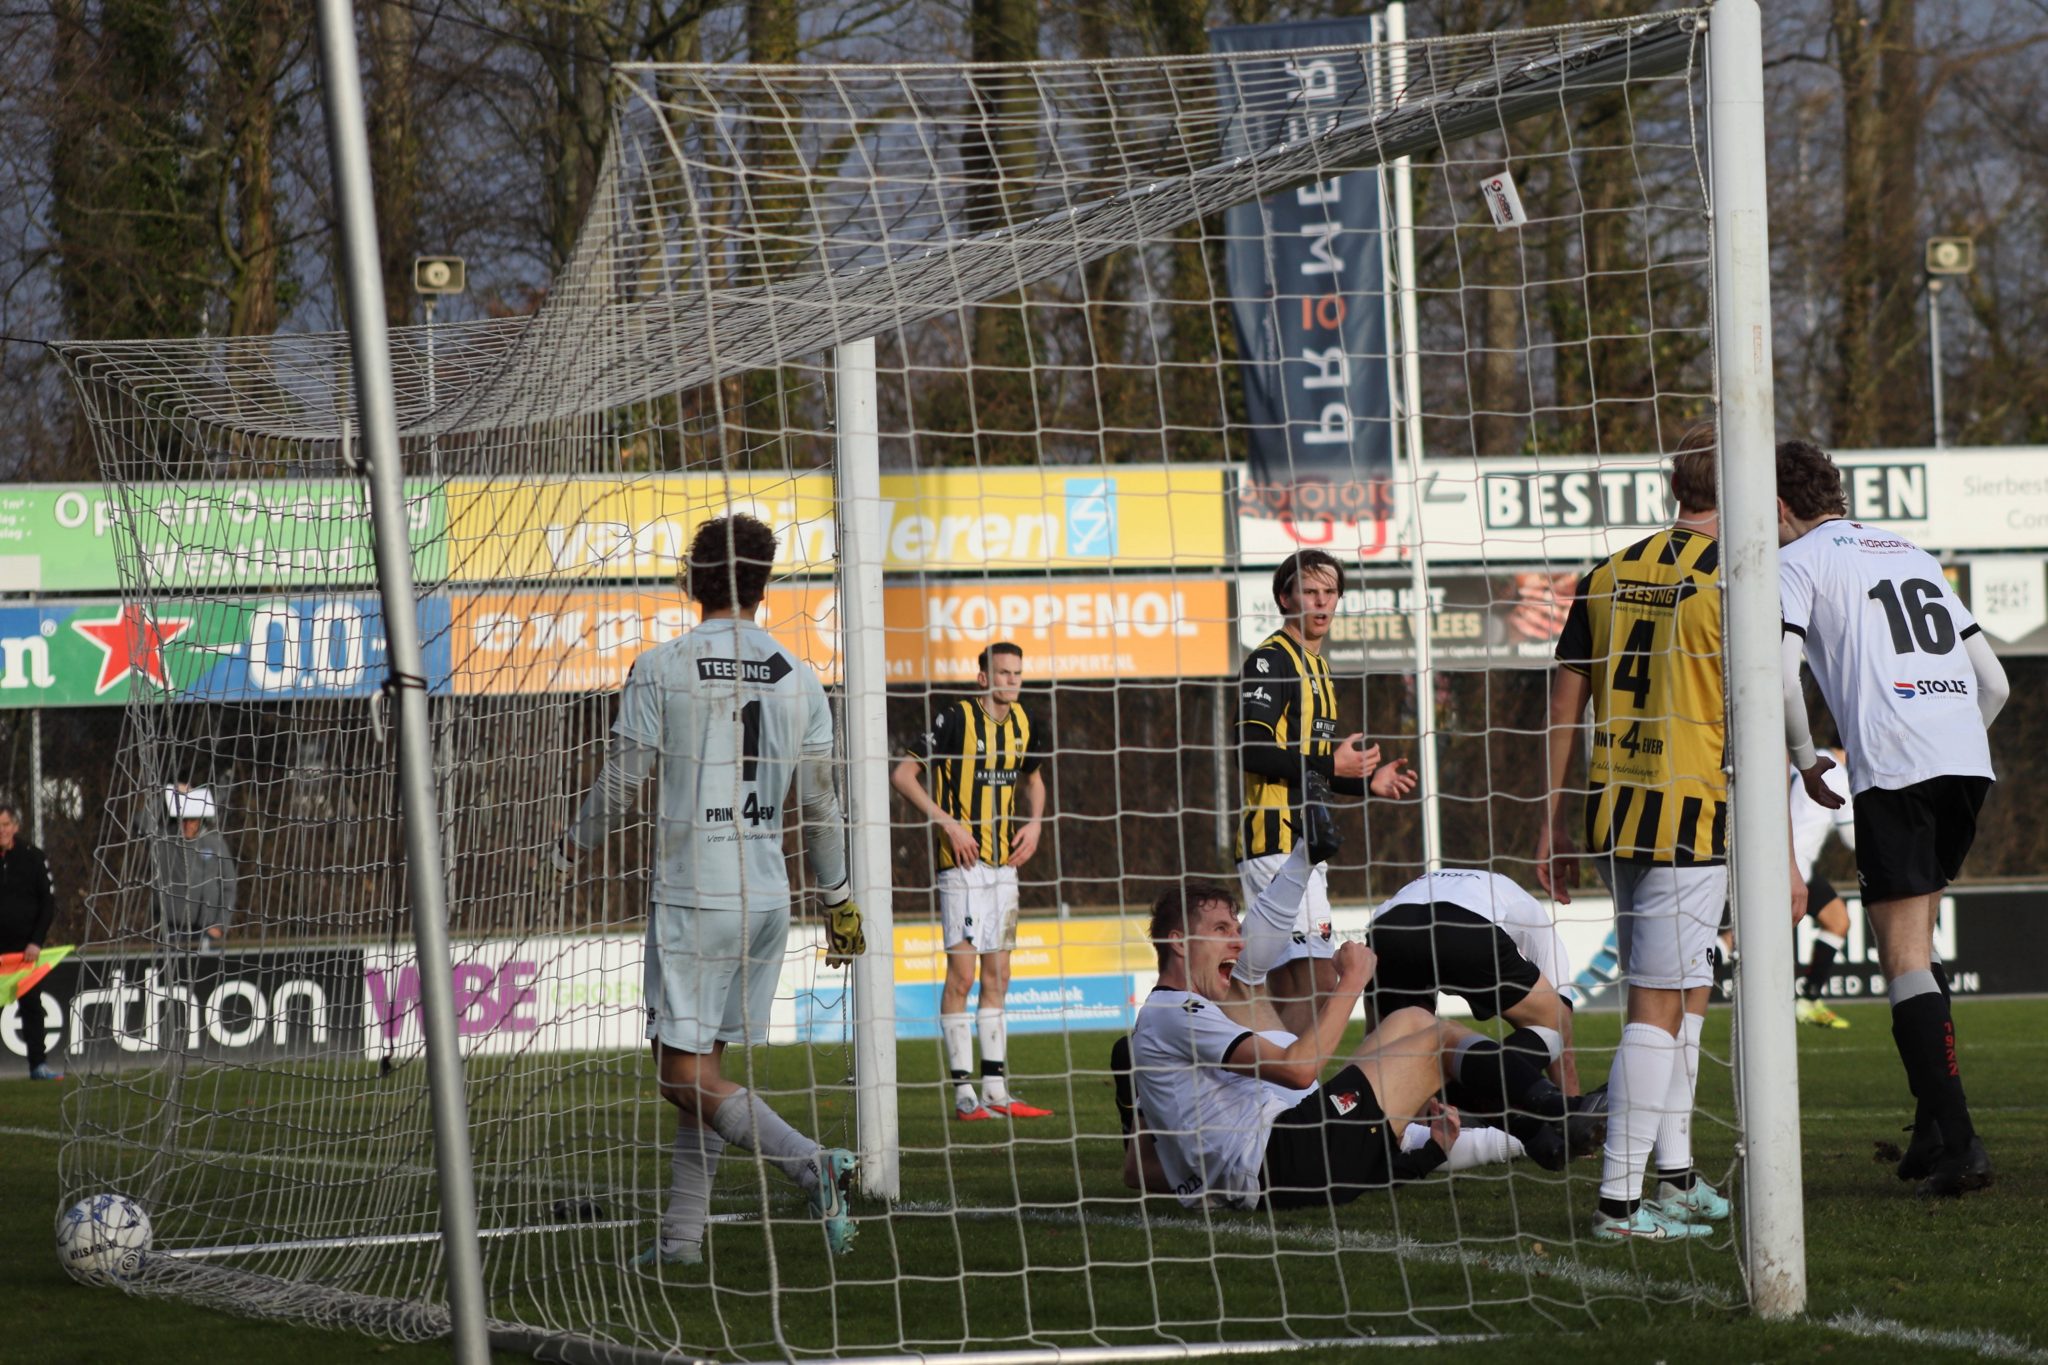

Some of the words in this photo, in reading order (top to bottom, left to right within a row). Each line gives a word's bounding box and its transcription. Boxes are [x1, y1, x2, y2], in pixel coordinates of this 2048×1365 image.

[156, 499, 211, 525] en
[227, 486, 431, 531] Overslg
[139, 536, 354, 578] Westland
[1400, 586, 1446, 615] HT
[1616, 583, 1677, 605] TEESING
[929, 590, 1198, 643] KOPPENOL
[1868, 577, 1956, 656] 16
[700, 660, 772, 680] TEESING
[1612, 618, 1656, 710] 4
[1917, 680, 1969, 696] STOLZE
[732, 699, 761, 782] 1
[1641, 737, 1665, 756] EVER
[706, 806, 740, 823] PRIN
[742, 791, 760, 827] 4
